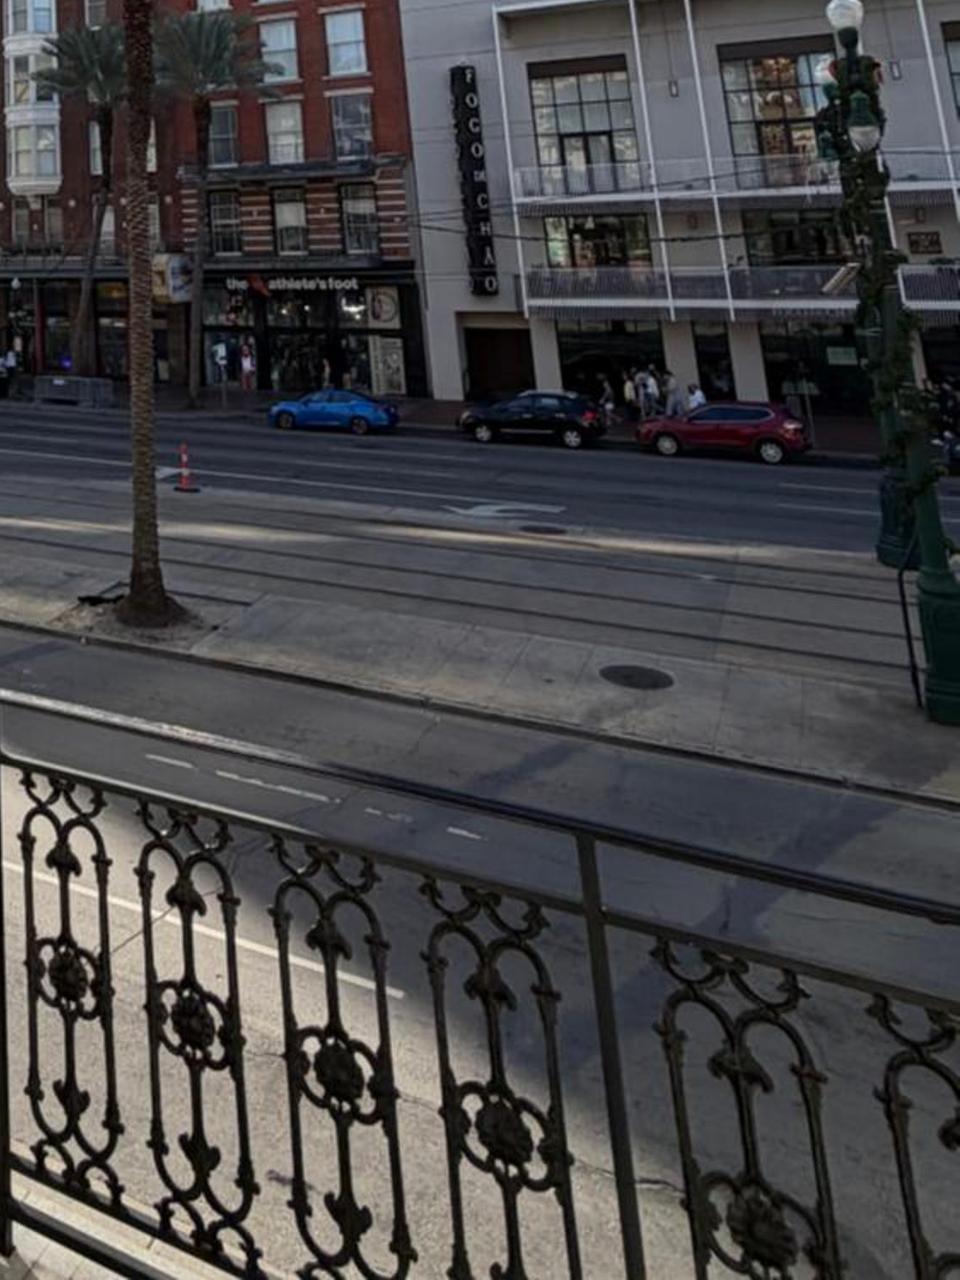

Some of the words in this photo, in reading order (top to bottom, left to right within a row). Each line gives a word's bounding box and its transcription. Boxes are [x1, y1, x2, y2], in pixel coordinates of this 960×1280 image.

[225, 276, 248, 290] the
[268, 276, 327, 290] athlete's
[328, 276, 359, 290] foot
